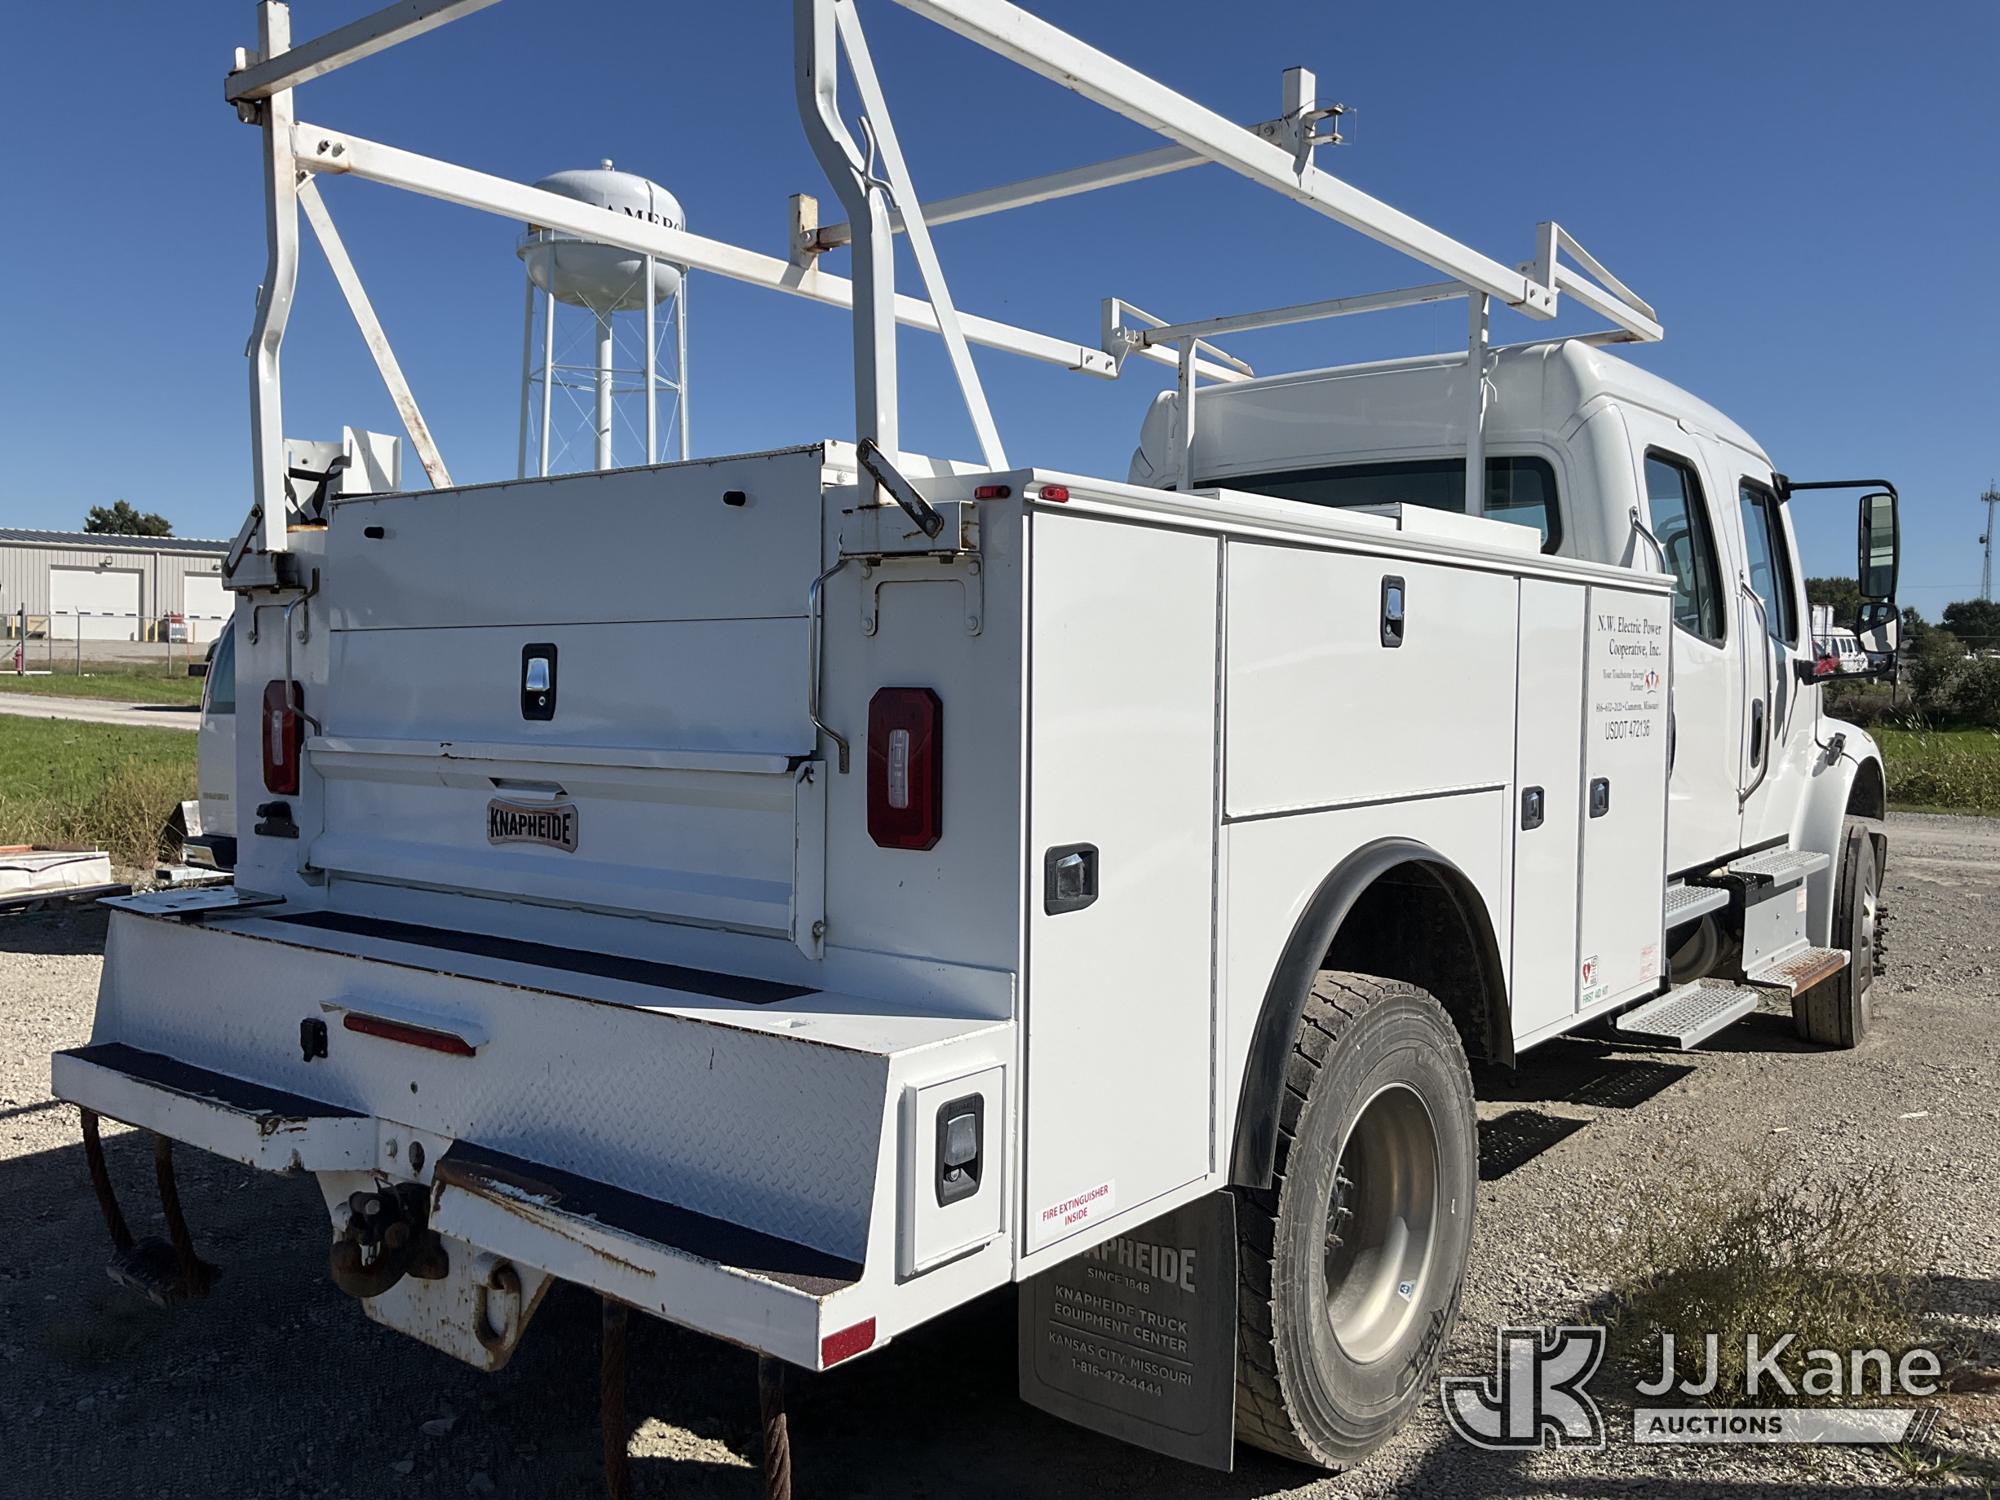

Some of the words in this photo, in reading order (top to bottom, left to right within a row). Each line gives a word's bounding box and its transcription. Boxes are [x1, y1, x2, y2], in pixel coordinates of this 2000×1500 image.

[1597, 615, 1616, 632] N.W.
[1618, 616, 1641, 634] Electric
[1643, 618, 1661, 635] Power
[1609, 638, 1648, 659] Cooperative,
[1649, 640, 1661, 656] Inc.
[1604, 720, 1628, 740] USDOT
[1628, 719, 1650, 738] 472136
[490, 806, 571, 845] KNAPHEIDE
[1042, 1206, 1058, 1222] FIRE
[1059, 1184, 1109, 1214] EXTINGUISHER
[1064, 1207, 1088, 1226] INSIDE
[1087, 1267, 1124, 1286] SINCE
[1125, 1277, 1150, 1294] 1848
[1054, 1303, 1129, 1335] EQUIPMENT
[1133, 1326, 1188, 1353] CENTER
[1055, 1285, 1135, 1317] KNAPHEIDE
[1139, 1309, 1188, 1334] TRUCK
[1049, 1331, 1095, 1355] KANSAS
[1099, 1348, 1127, 1368] CITY,
[1130, 1357, 1193, 1385] MISSOURI
[1071, 1357, 1163, 1396] 1-816-472-4444
